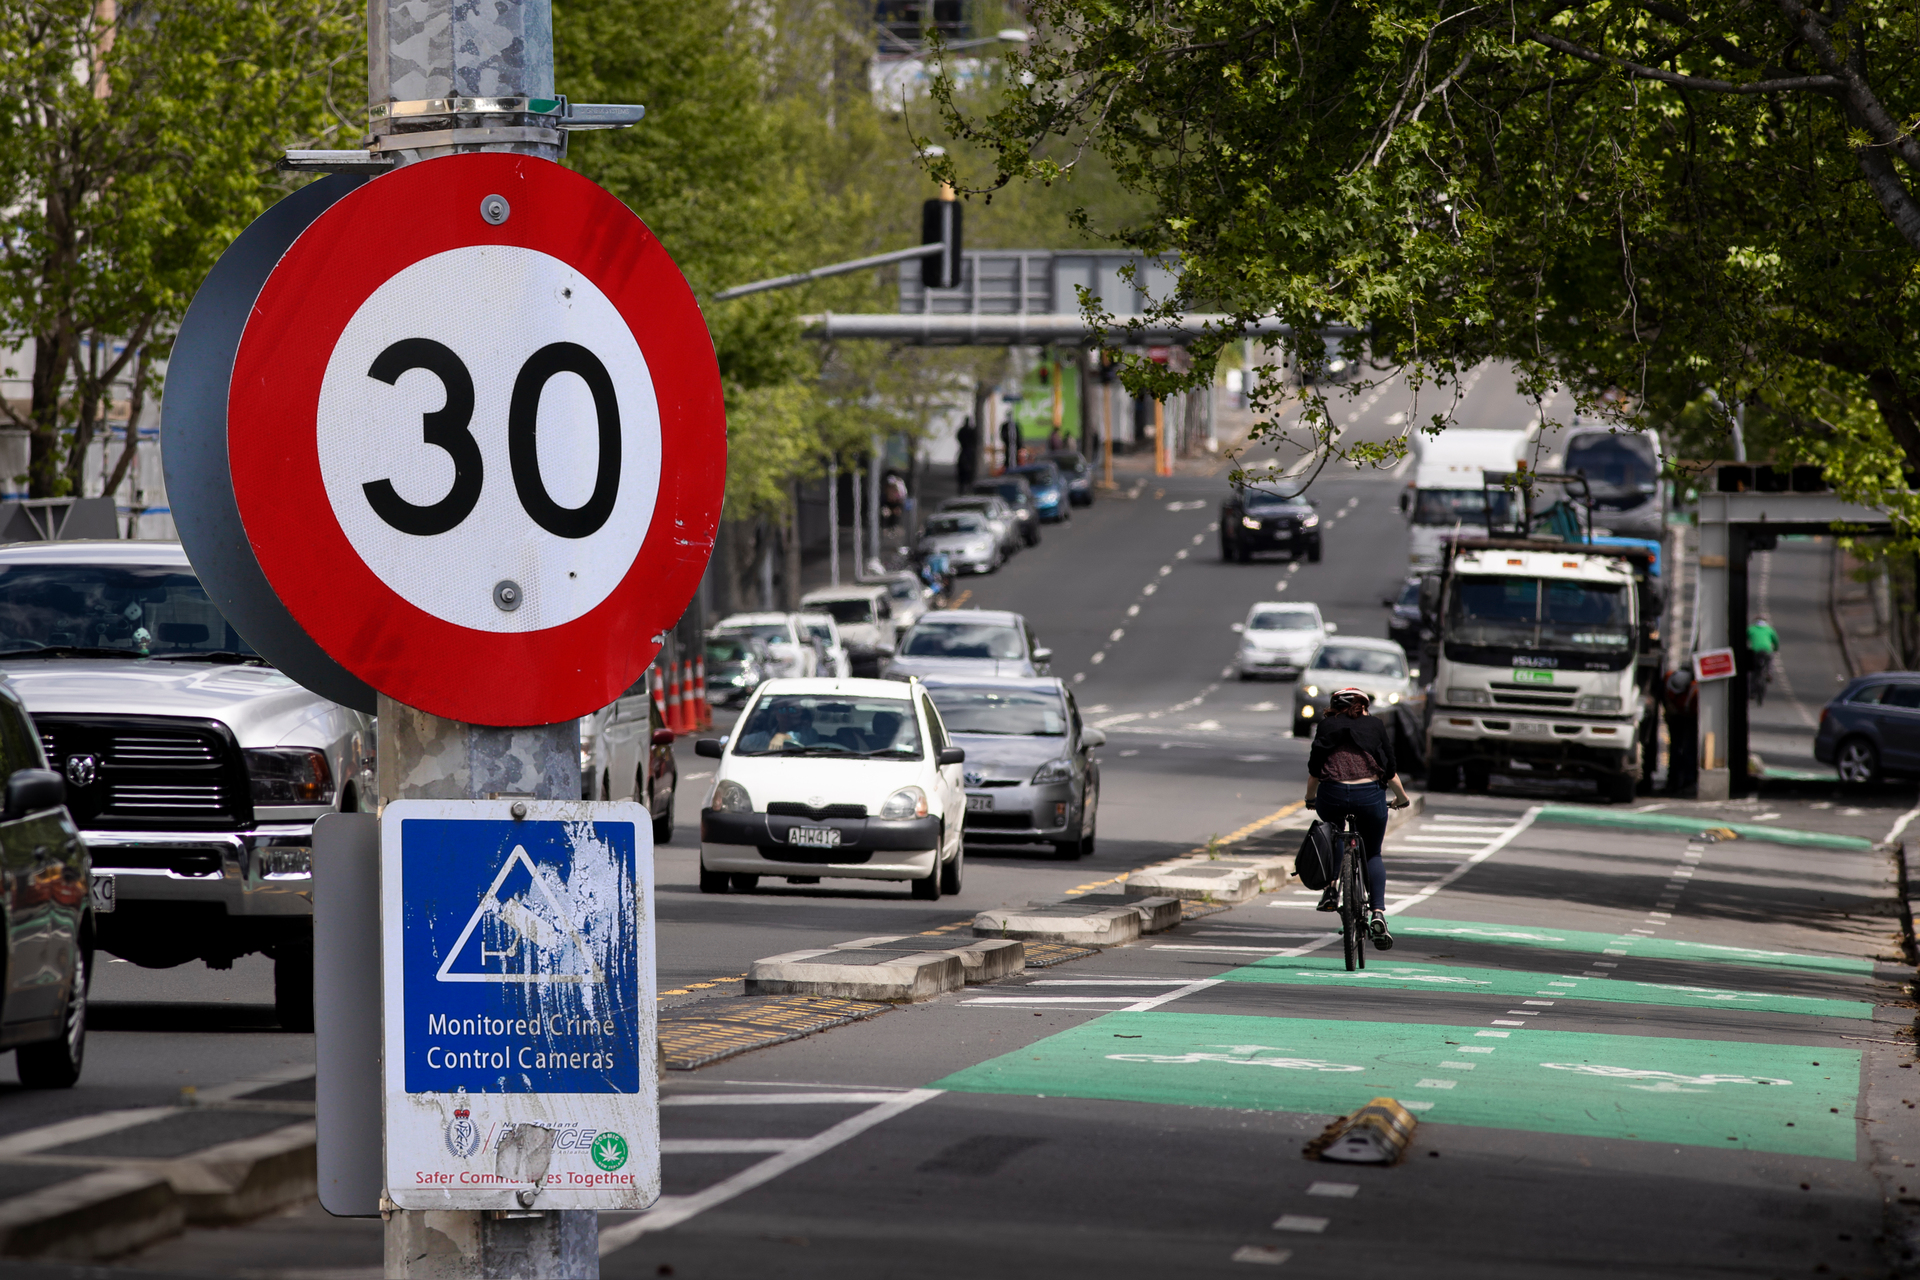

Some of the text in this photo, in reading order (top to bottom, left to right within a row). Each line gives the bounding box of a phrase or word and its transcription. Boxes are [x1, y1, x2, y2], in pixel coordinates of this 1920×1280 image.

[361, 337, 622, 539] 30
[1512, 655, 1559, 669] ISUZU
[790, 828, 840, 845] AHW412
[428, 1013, 615, 1036] Monitored Crime
[427, 1045, 614, 1070] Control Cameras
[594, 1133, 620, 1146] COSMIC
[416, 1171, 454, 1184] Safer
[567, 1172, 636, 1188] Together
